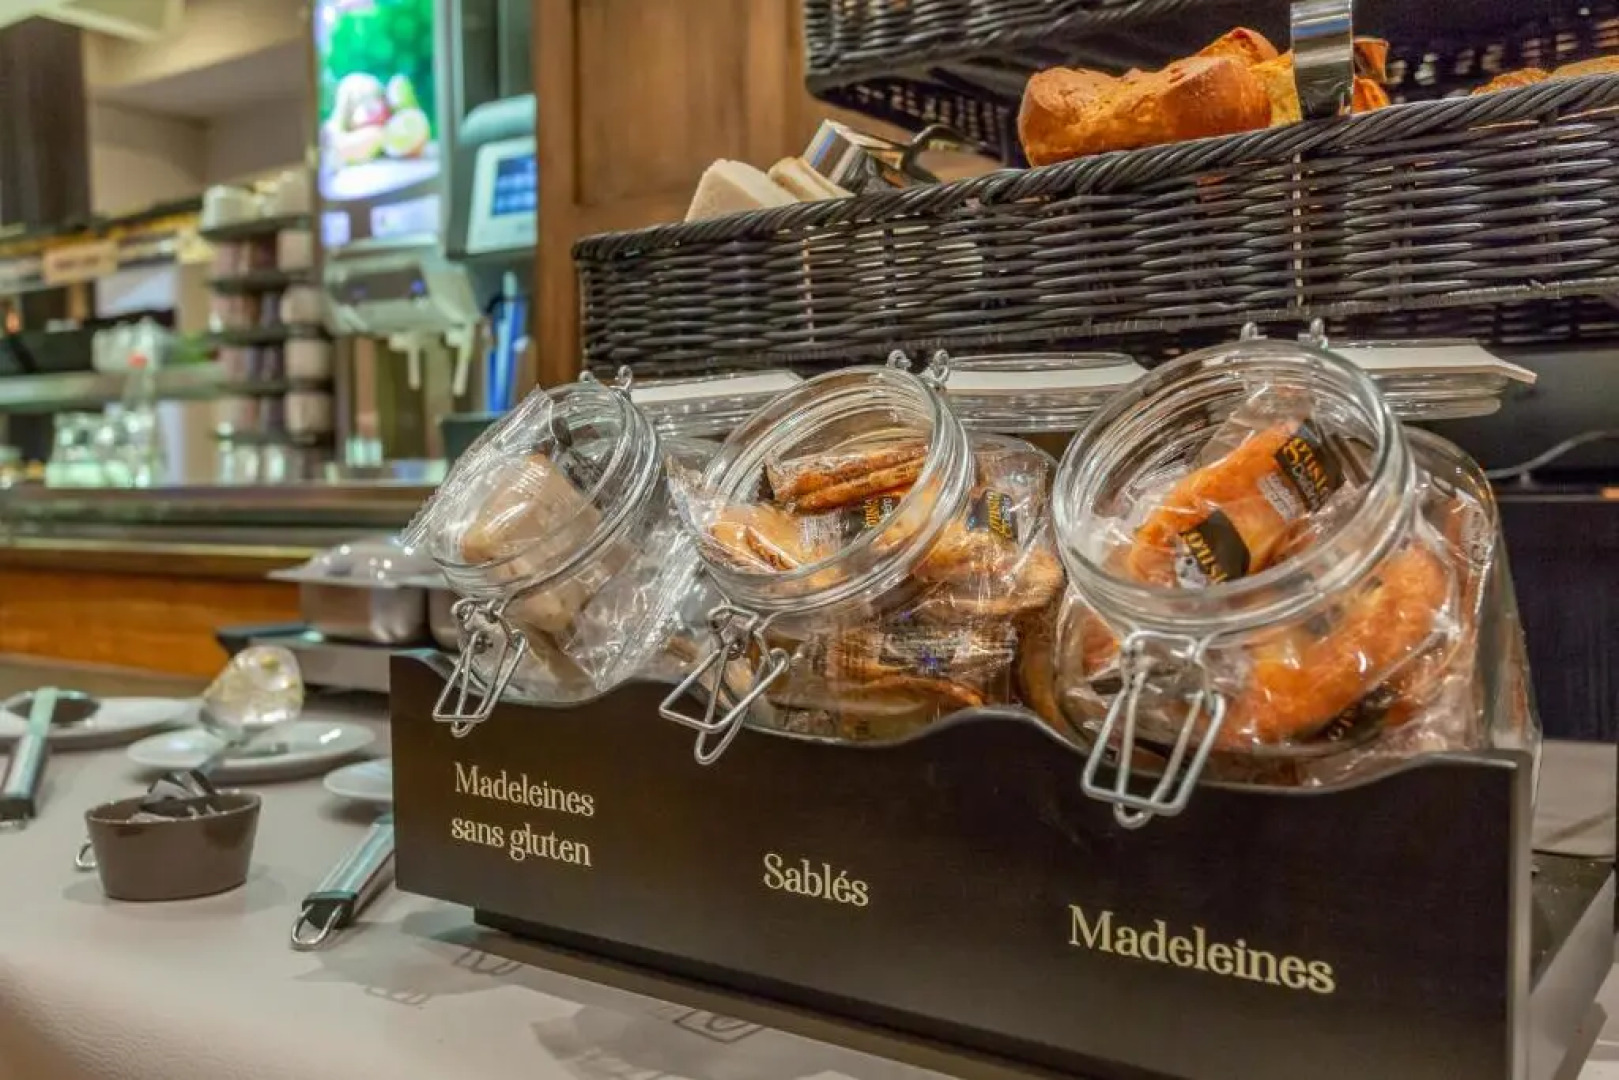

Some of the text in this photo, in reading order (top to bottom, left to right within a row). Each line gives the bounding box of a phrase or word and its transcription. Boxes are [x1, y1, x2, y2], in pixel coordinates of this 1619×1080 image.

[455, 763, 594, 816] Madeleines
[451, 816, 591, 866] sans gluten
[764, 853, 868, 906] Sablés
[1069, 904, 1335, 993] Madeleines
